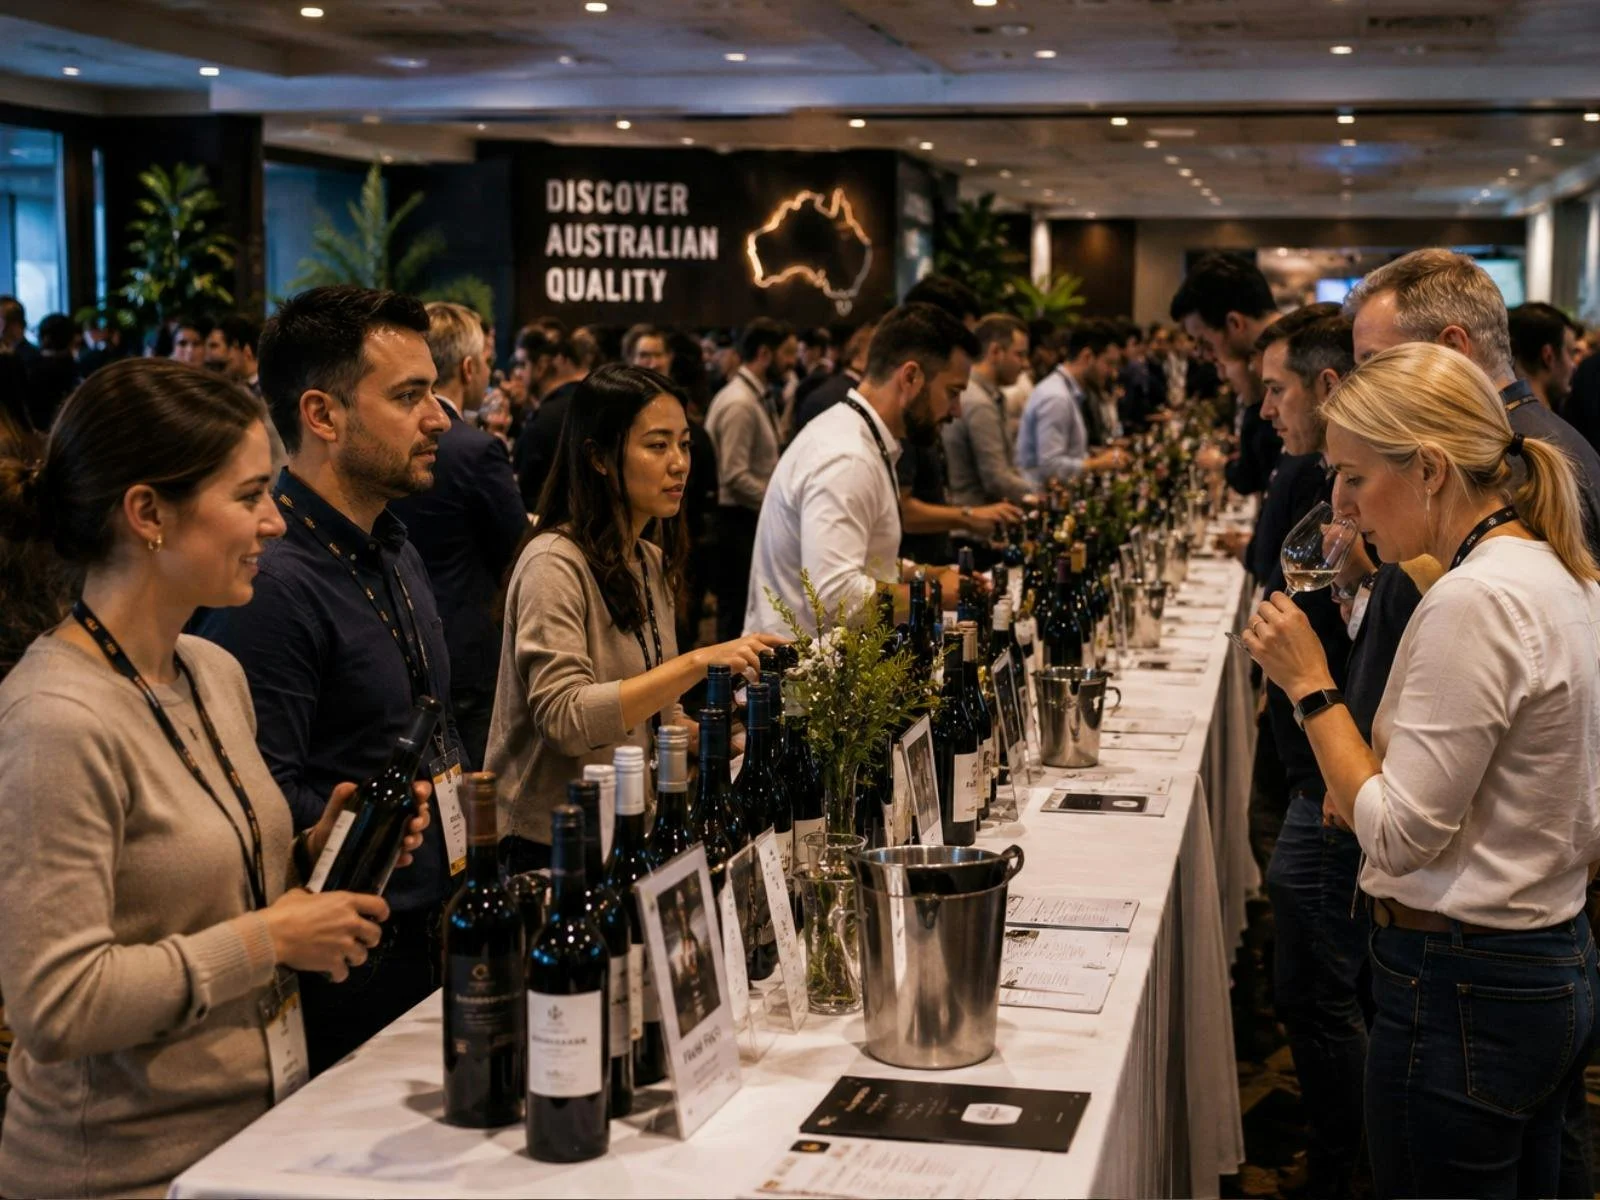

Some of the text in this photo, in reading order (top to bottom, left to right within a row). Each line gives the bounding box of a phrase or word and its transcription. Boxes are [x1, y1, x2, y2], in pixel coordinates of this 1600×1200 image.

[546, 179, 688, 215] DISCOVER
[545, 223, 718, 260] AUSTRALIAN
[545, 267, 667, 303] QUALITY
